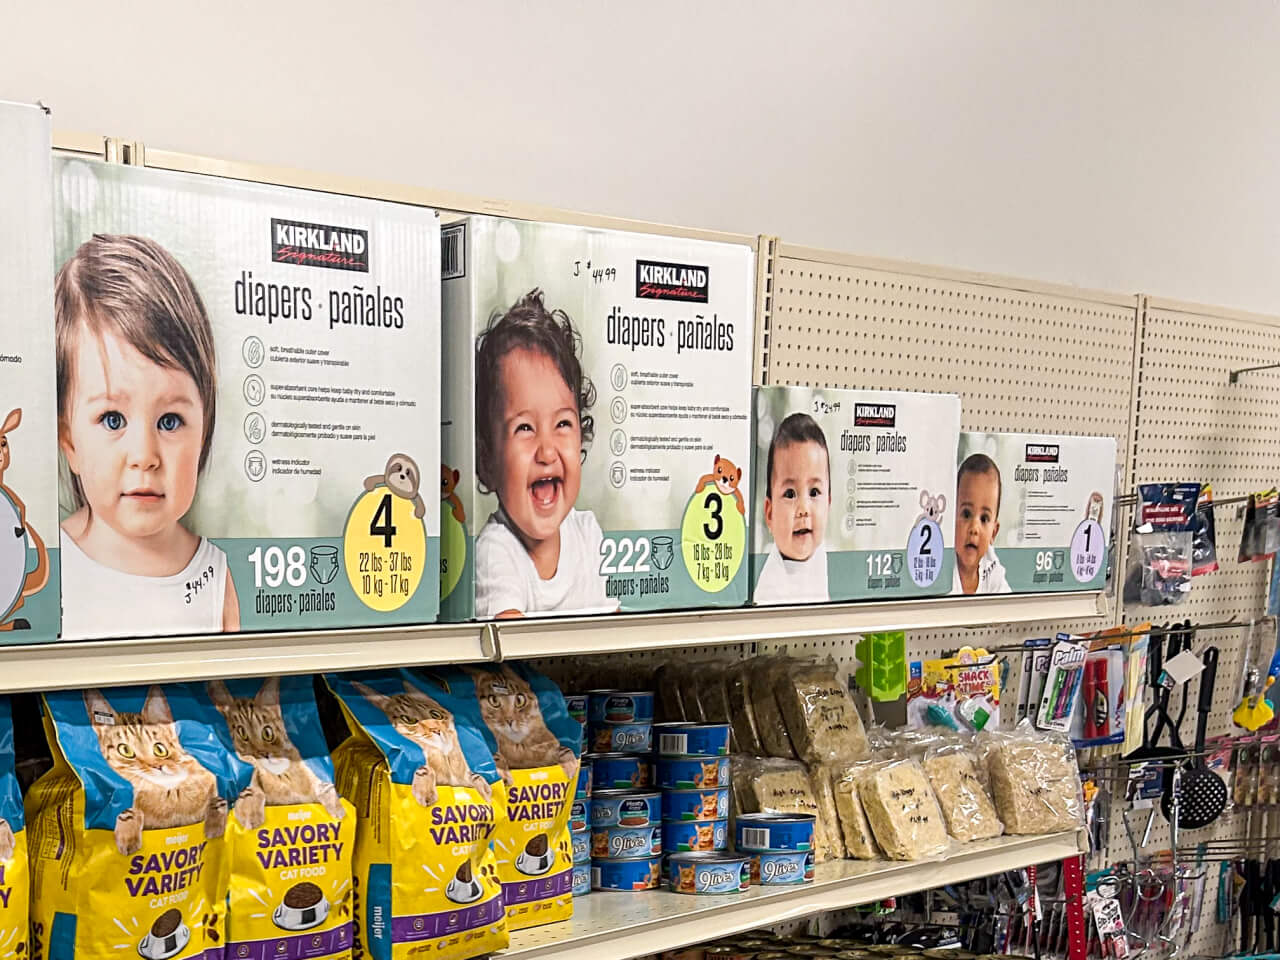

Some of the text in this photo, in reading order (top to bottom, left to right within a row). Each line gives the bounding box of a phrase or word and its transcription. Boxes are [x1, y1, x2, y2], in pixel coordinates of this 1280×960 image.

[276, 224, 365, 254] KIRKLAND
[276, 247, 365, 266] Signature
[640, 264, 706, 288] KIRKLAND
[235, 271, 404, 329] diapers pañales
[607, 306, 734, 354] diapers pañales
[856, 406, 894, 418] KIRKLAND
[841, 430, 906, 454] diapers pañales
[1014, 464, 1038, 483] diapers
[370, 494, 396, 548] 4
[703, 493, 723, 540] 3
[920, 525, 932, 555] 2
[1083, 525, 1092, 552] 1
[248, 546, 307, 588] 198
[359, 553, 412, 572] 22 lbs 37 lbs
[600, 537, 650, 574] 222
[867, 554, 892, 575] 112
[1036, 552, 1053, 571] 96
[362, 575, 409, 597] 10 kg 17 kg
[606, 574, 669, 599] diapers pañales
[255, 589, 335, 617] diapers pañales
[1054, 650, 1084, 665] Palm
[959, 670, 989, 680] SNACK
[508, 782, 570, 804] SAVORY
[431, 804, 494, 826] SAVORY
[257, 822, 342, 849] SAVORY
[129, 841, 208, 876] SAVORY
[256, 842, 345, 871] VARIETY
[125, 862, 205, 897] VARIETY
